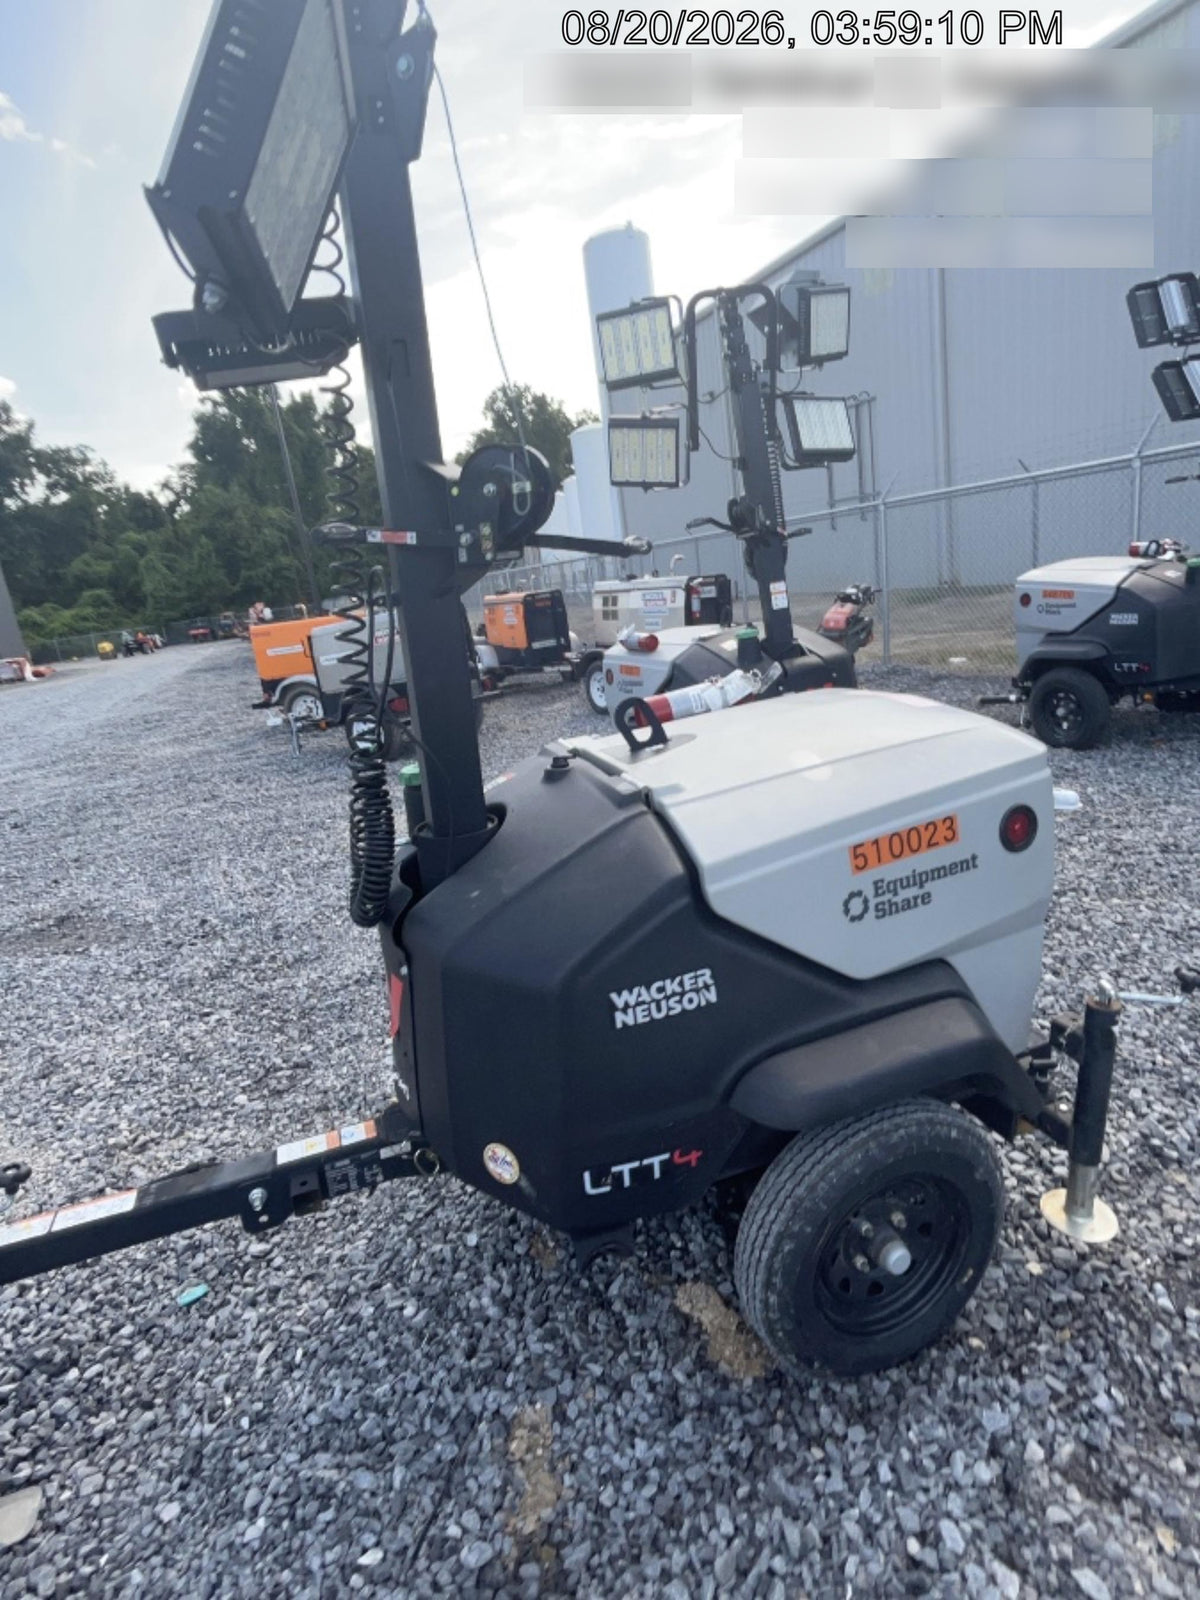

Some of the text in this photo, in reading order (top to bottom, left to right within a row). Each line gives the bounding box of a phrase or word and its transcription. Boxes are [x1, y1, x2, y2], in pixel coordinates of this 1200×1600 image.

[853, 815, 957, 871] 510023
[872, 853, 979, 898] Equipment
[874, 891, 933, 920] Share
[609, 967, 715, 1010] WACKER
[614, 985, 718, 1030] NEUSON
[582, 1148, 703, 1196] LTT4
